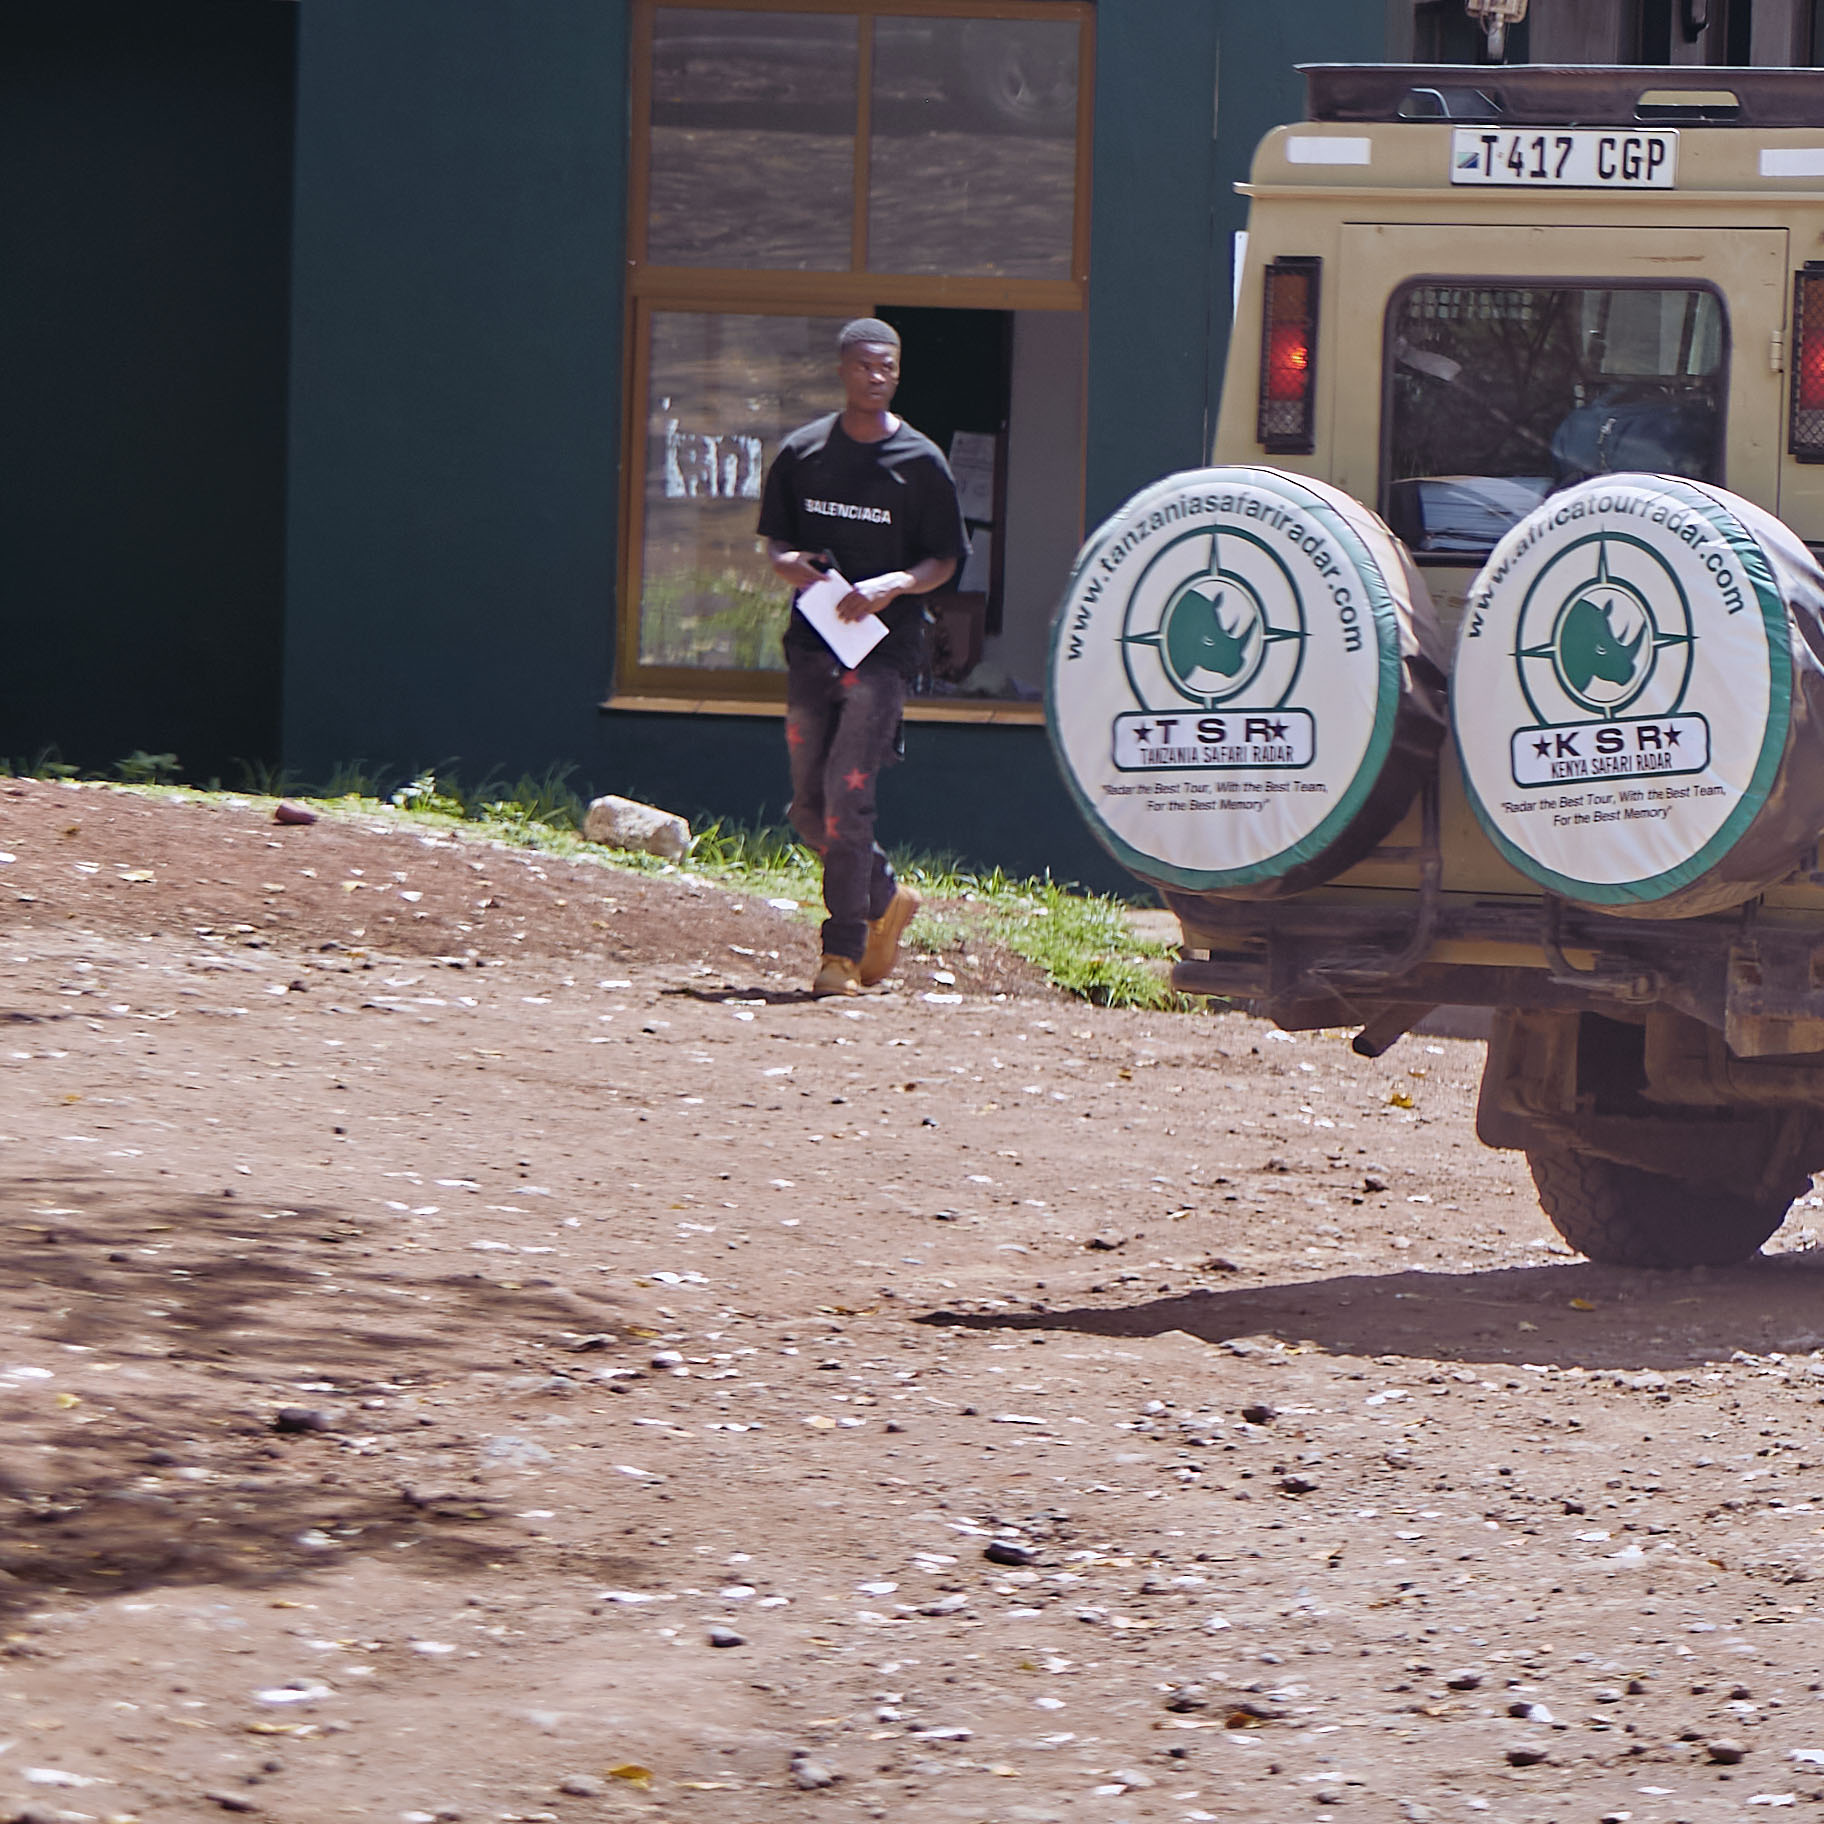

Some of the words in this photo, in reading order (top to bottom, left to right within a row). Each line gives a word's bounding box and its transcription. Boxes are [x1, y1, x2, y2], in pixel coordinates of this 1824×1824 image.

[1481, 135, 1498, 176] T
[1507, 136, 1572, 178] 417
[1599, 137, 1664, 180] CGP
[804, 498, 892, 525] BALENCIAGA
[1068, 492, 1363, 661] www.tanzaniasafariradar.com
[1468, 494, 1744, 638] www.africatourradar.com
[1140, 747, 1198, 764] TANZANIA
[1204, 746, 1247, 763] SAFARI
[1253, 745, 1294, 763] RADAR
[1552, 759, 1587, 778] KENYA
[1592, 755, 1632, 775] SAFARI
[1637, 752, 1672, 771] RADAR
[1540, 798, 1557, 810] the
[1560, 796, 1584, 808] Best
[1620, 789, 1644, 802] With
[1648, 788, 1663, 800] the
[1666, 787, 1690, 799] Best
[1554, 815, 1571, 826] For
[1574, 813, 1591, 825] the
[1594, 810, 1621, 822] Best
